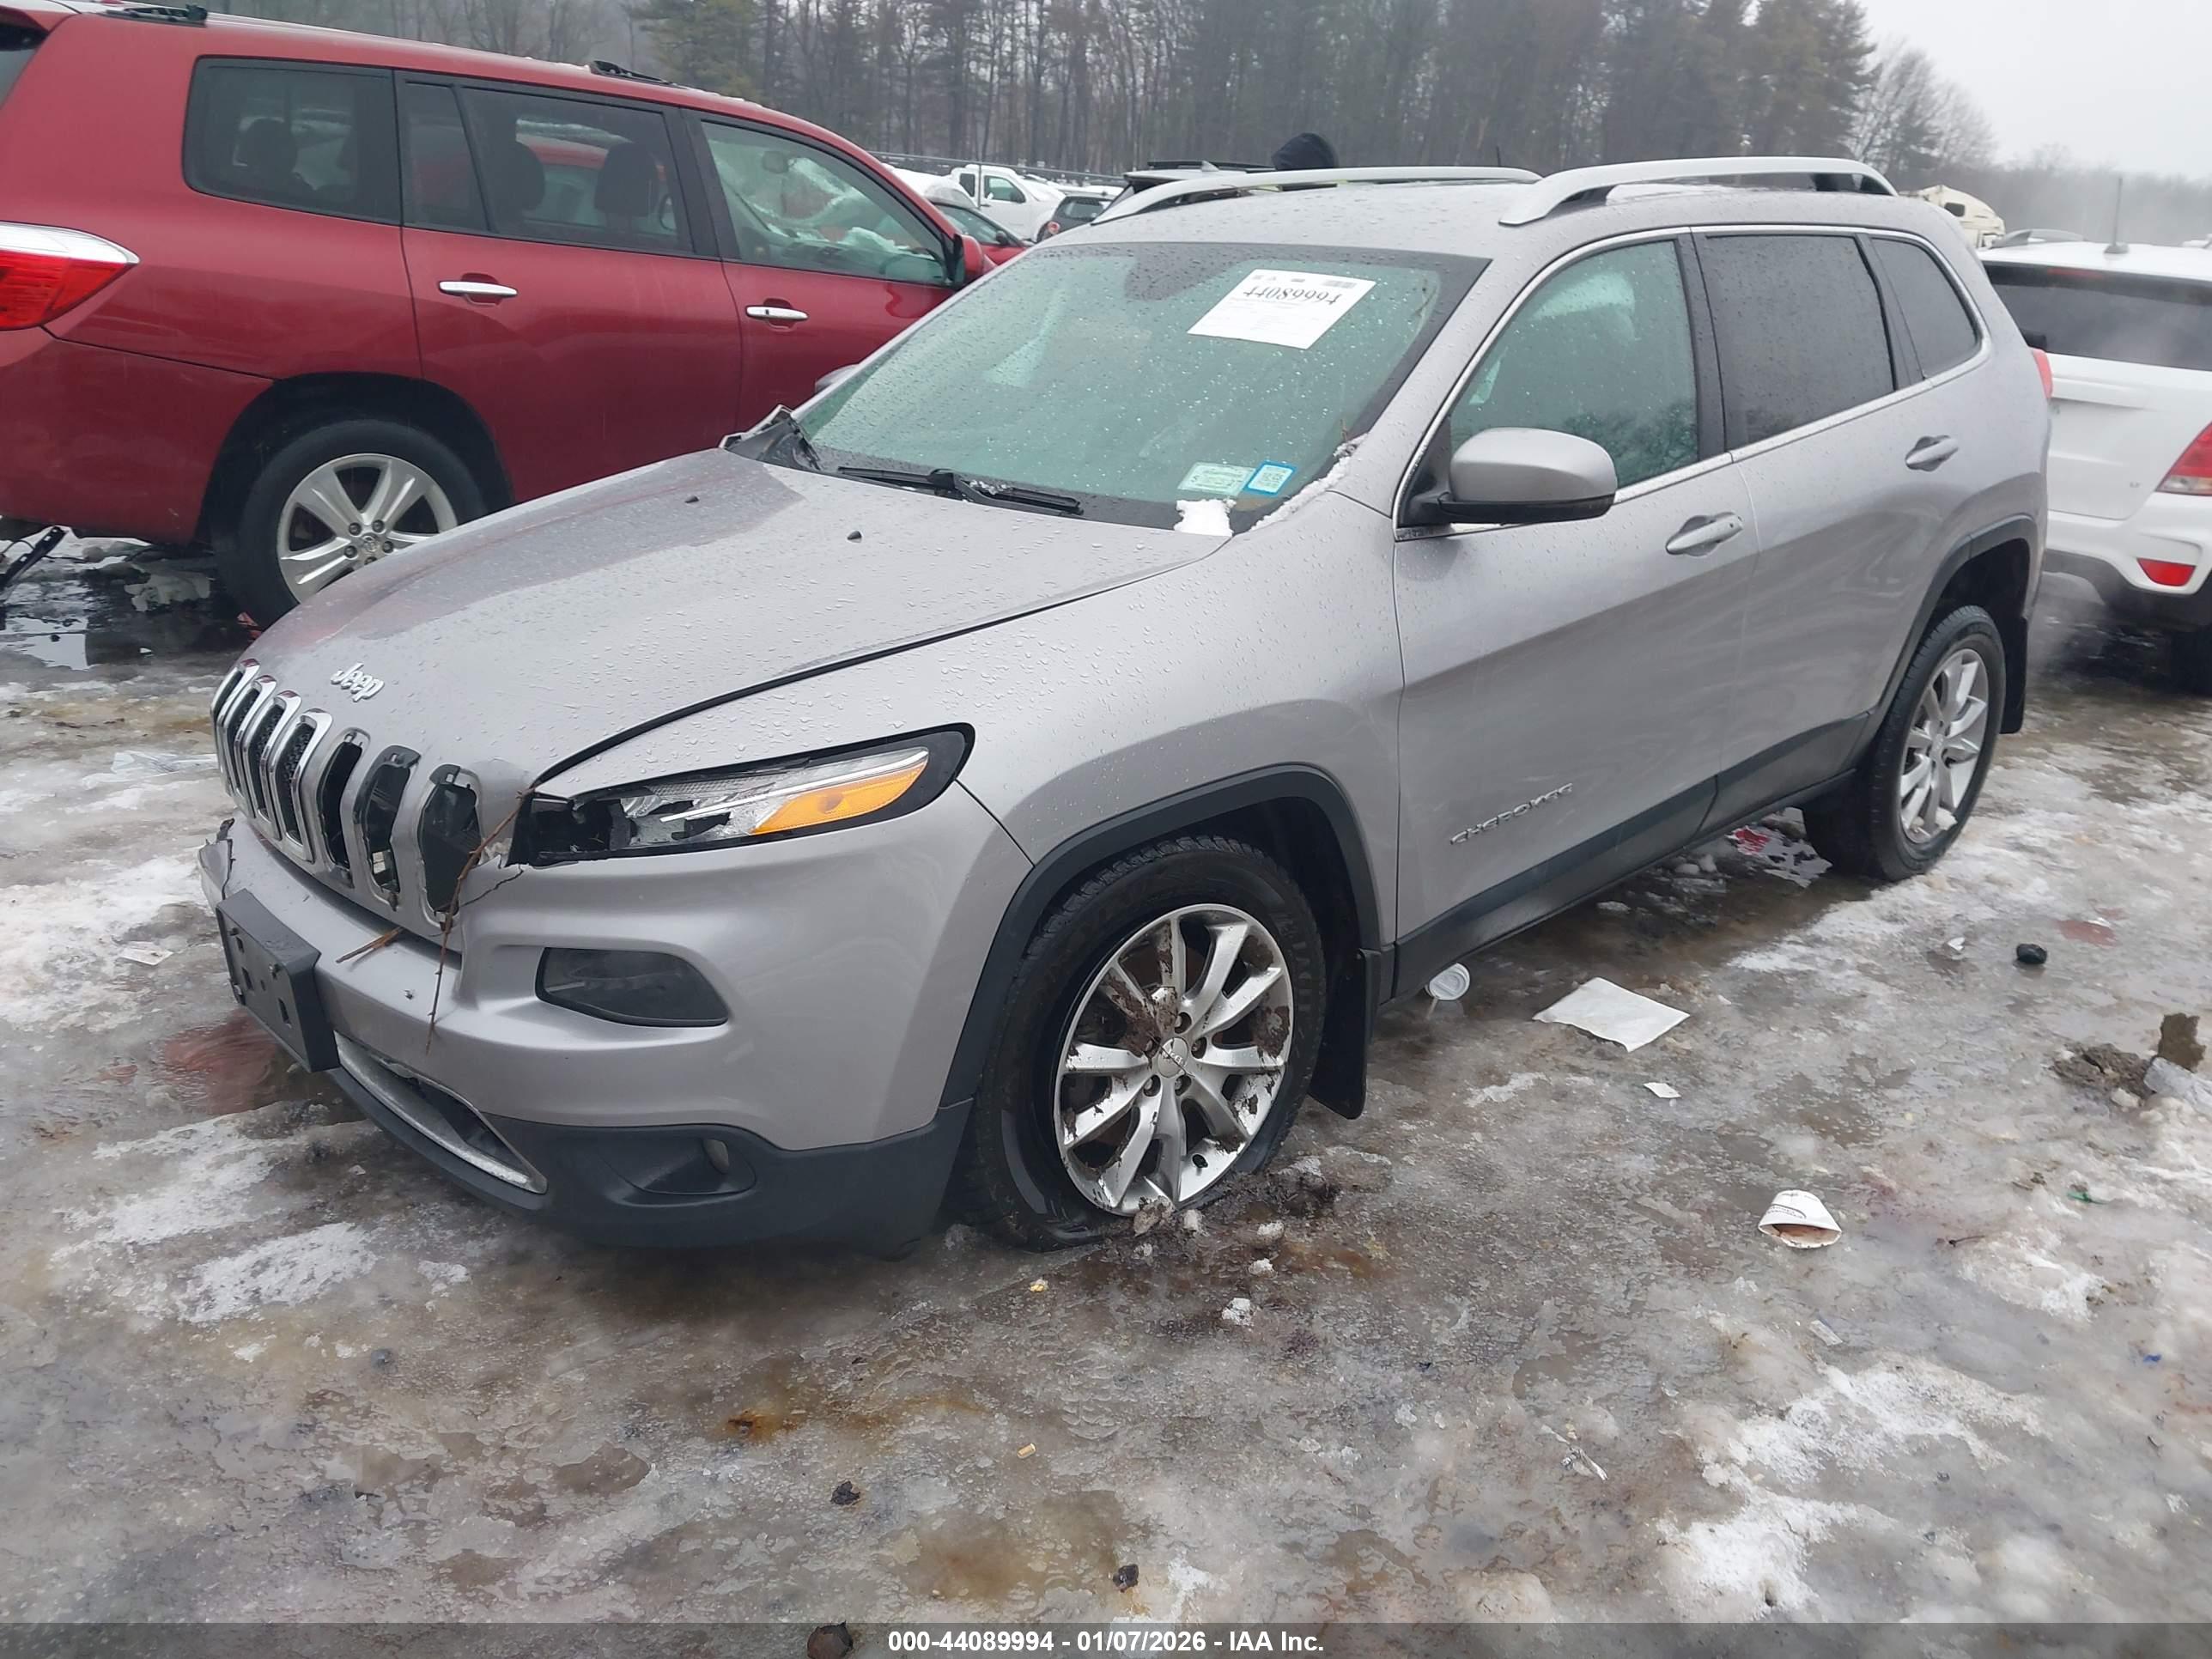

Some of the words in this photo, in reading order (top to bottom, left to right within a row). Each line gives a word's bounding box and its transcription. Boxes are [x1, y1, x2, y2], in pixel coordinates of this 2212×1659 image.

[1243, 285, 1343, 306] 44089994
[330, 662, 385, 703] Jeep
[1449, 782, 1573, 845] CHEROKEE
